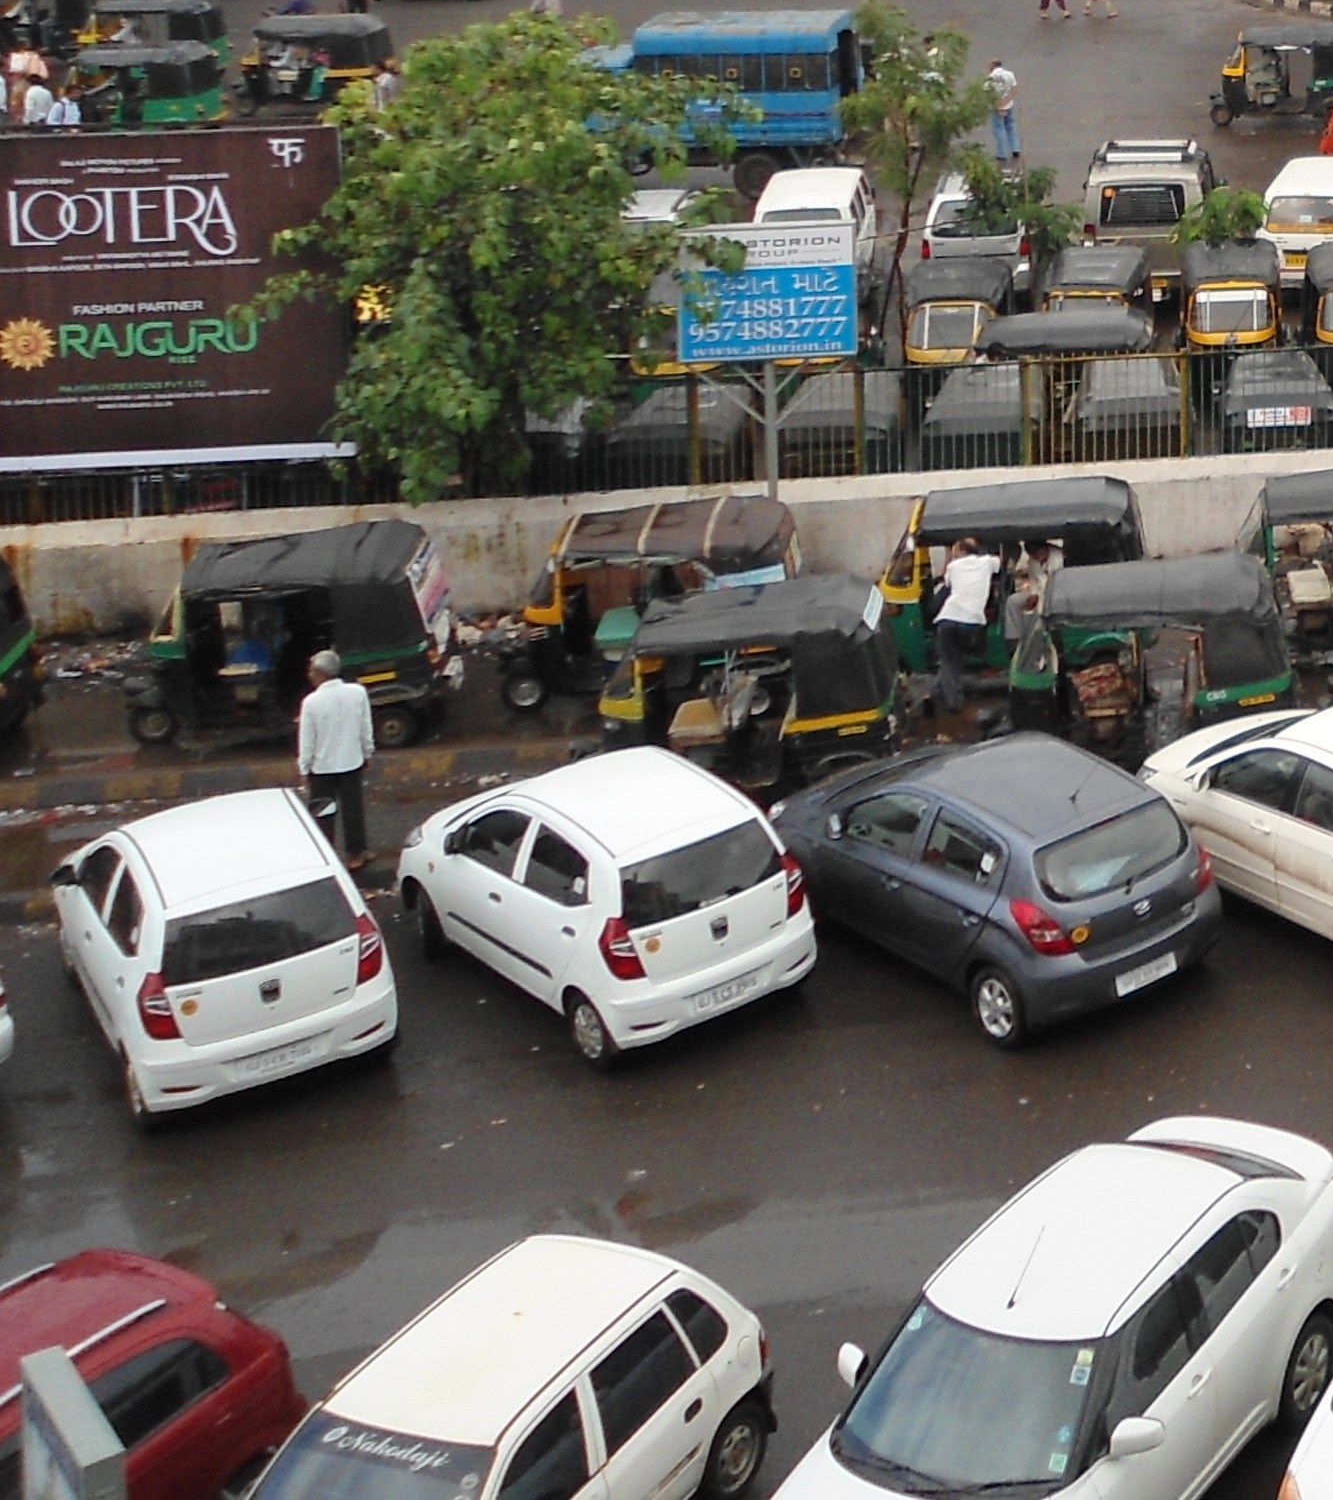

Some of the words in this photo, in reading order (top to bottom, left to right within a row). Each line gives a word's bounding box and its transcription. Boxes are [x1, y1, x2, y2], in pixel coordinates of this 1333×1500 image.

[9, 185, 238, 256] LOOTERA
[746, 236, 841, 248] STORION
[73, 303, 135, 316] FASHION
[137, 300, 204, 313] PARTNER
[59, 317, 260, 361] RAJGURU
[689, 316, 848, 343] 9574882777
[692, 339, 843, 358] www.astorion.in
[338, 1432, 449, 1472] Nakodaji
